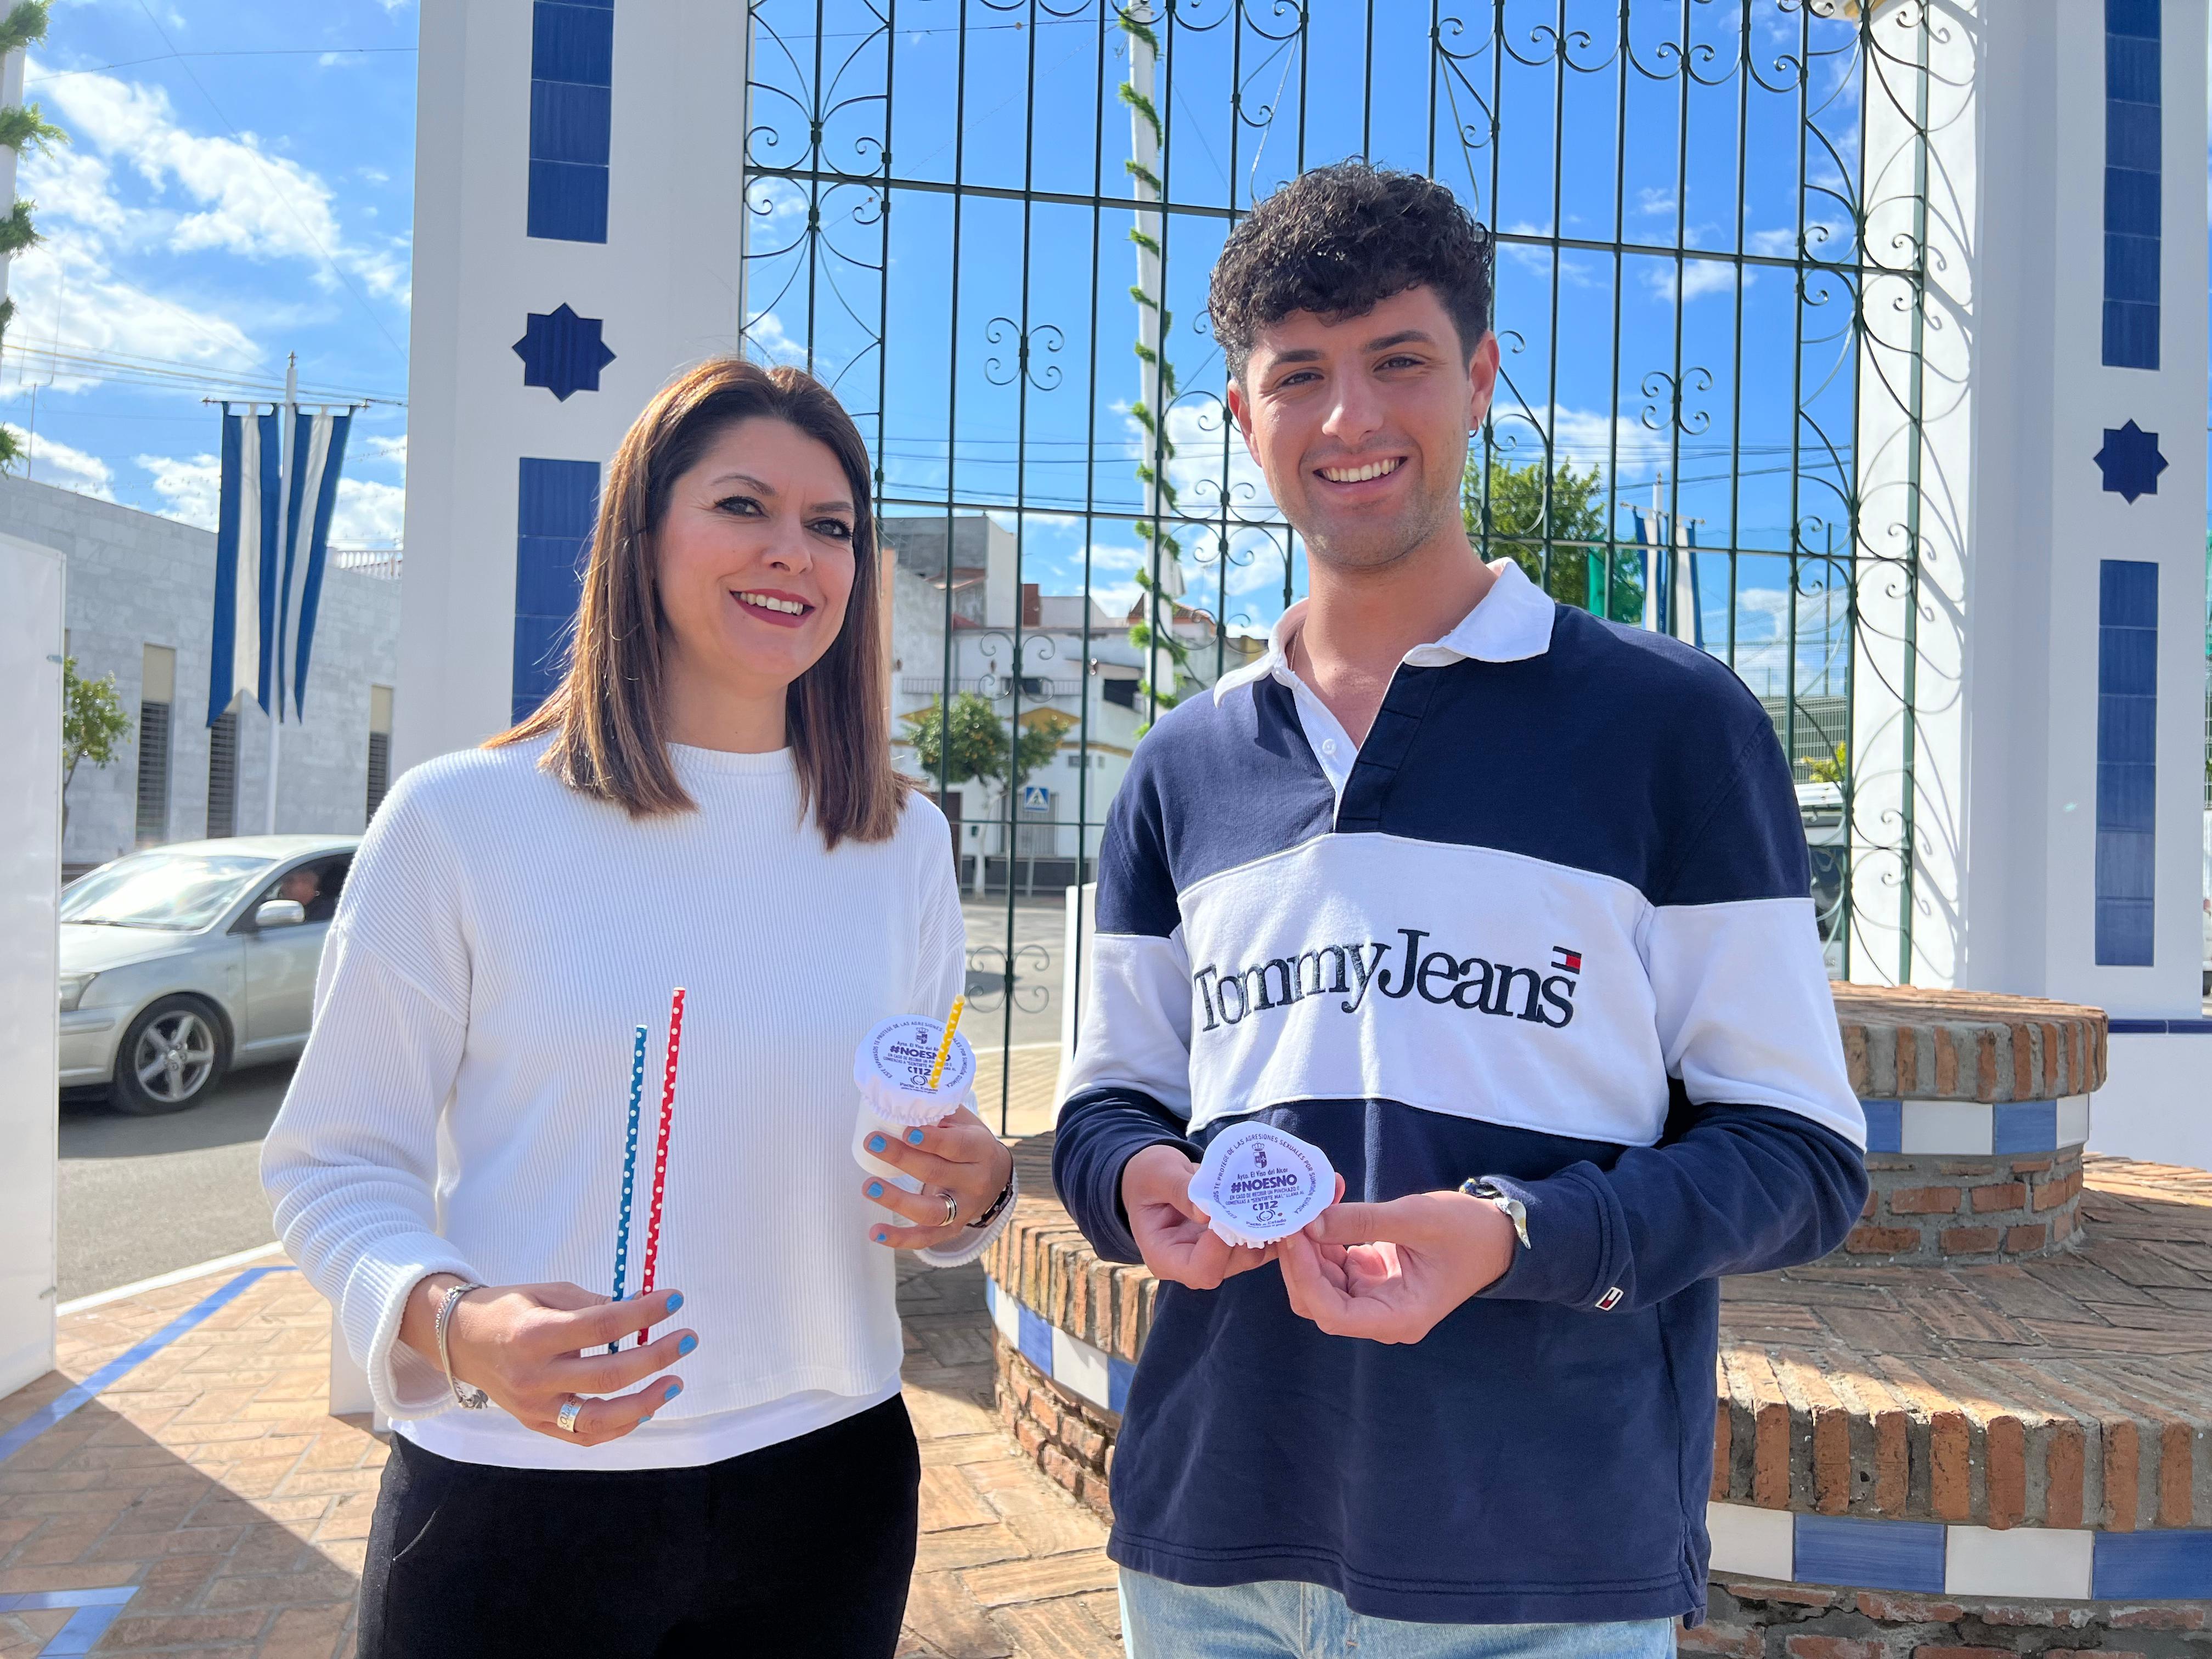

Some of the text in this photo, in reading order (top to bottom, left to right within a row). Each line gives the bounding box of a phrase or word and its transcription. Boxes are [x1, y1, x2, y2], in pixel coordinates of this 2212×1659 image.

[1194, 929, 1577, 1031] TommyJeans
[1217, 1154, 1229, 1181] PROTEGE
[1227, 1147, 1234, 1155] DE
[1233, 1139, 1244, 1149] LAS
[1246, 1133, 1278, 1143] AGRESIONES
[1279, 1139, 1305, 1160] SEXUALES
[1304, 1160, 1313, 1171] POR
[1231, 1173, 1297, 1193] #NOESNO
